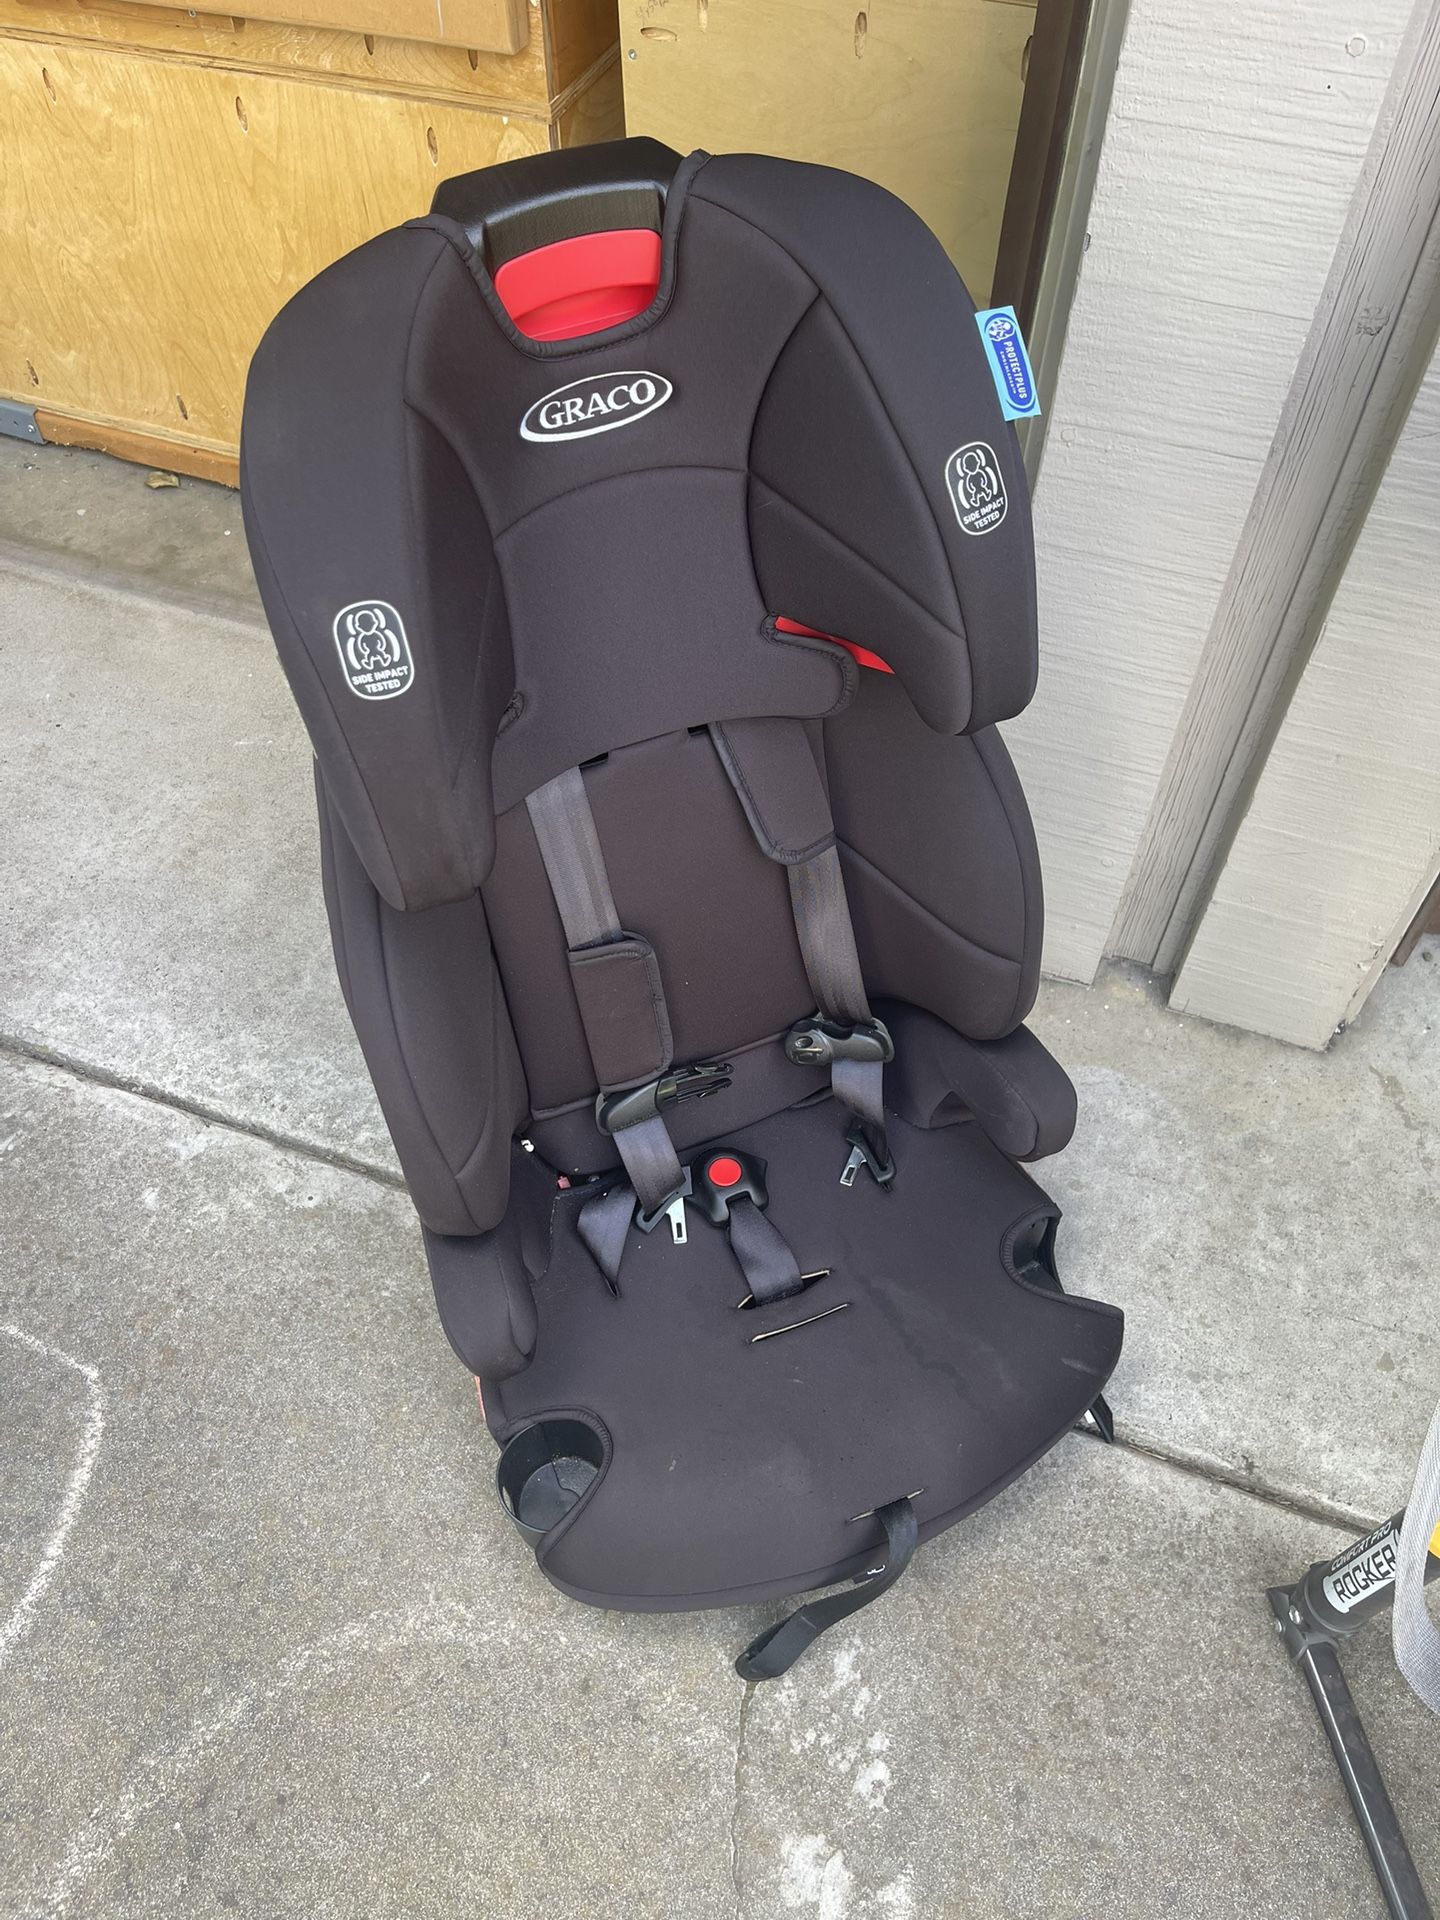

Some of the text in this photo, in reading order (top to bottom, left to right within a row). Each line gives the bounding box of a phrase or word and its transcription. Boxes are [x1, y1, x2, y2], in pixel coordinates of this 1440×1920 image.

[1003, 341, 1027, 399] PROTECTPLUS
[539, 379, 656, 429] GRACO
[963, 497, 1004, 525] SIDE IMPACT
[974, 510, 1000, 529] TESTED
[352, 665, 408, 685] SIDE IMPACT
[365, 679, 401, 693] TESTED
[1331, 1521, 1391, 1571] COMFORT PRO
[1332, 1544, 1396, 1603] ROCKER
